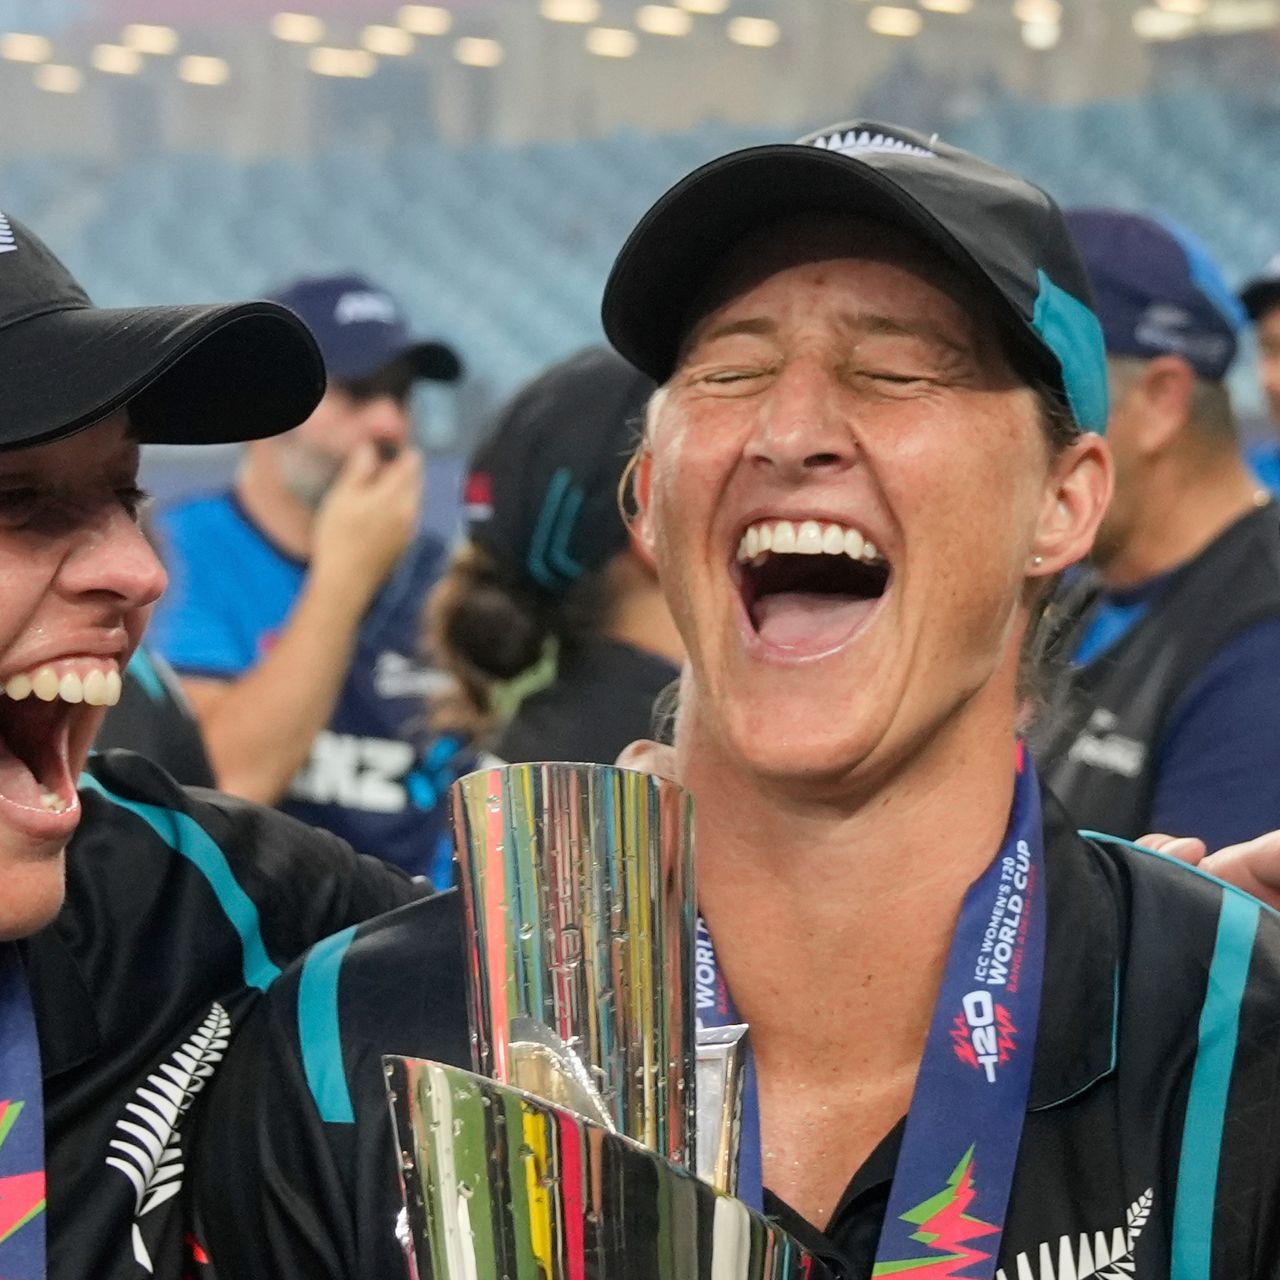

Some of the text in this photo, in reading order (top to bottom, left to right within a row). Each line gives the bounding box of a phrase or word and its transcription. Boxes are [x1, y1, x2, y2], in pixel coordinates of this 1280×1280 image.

[974, 856, 1016, 982] ICC WOMEN'S T20
[986, 839, 1032, 985] WORLD CUP
[962, 990, 999, 1084] T20
